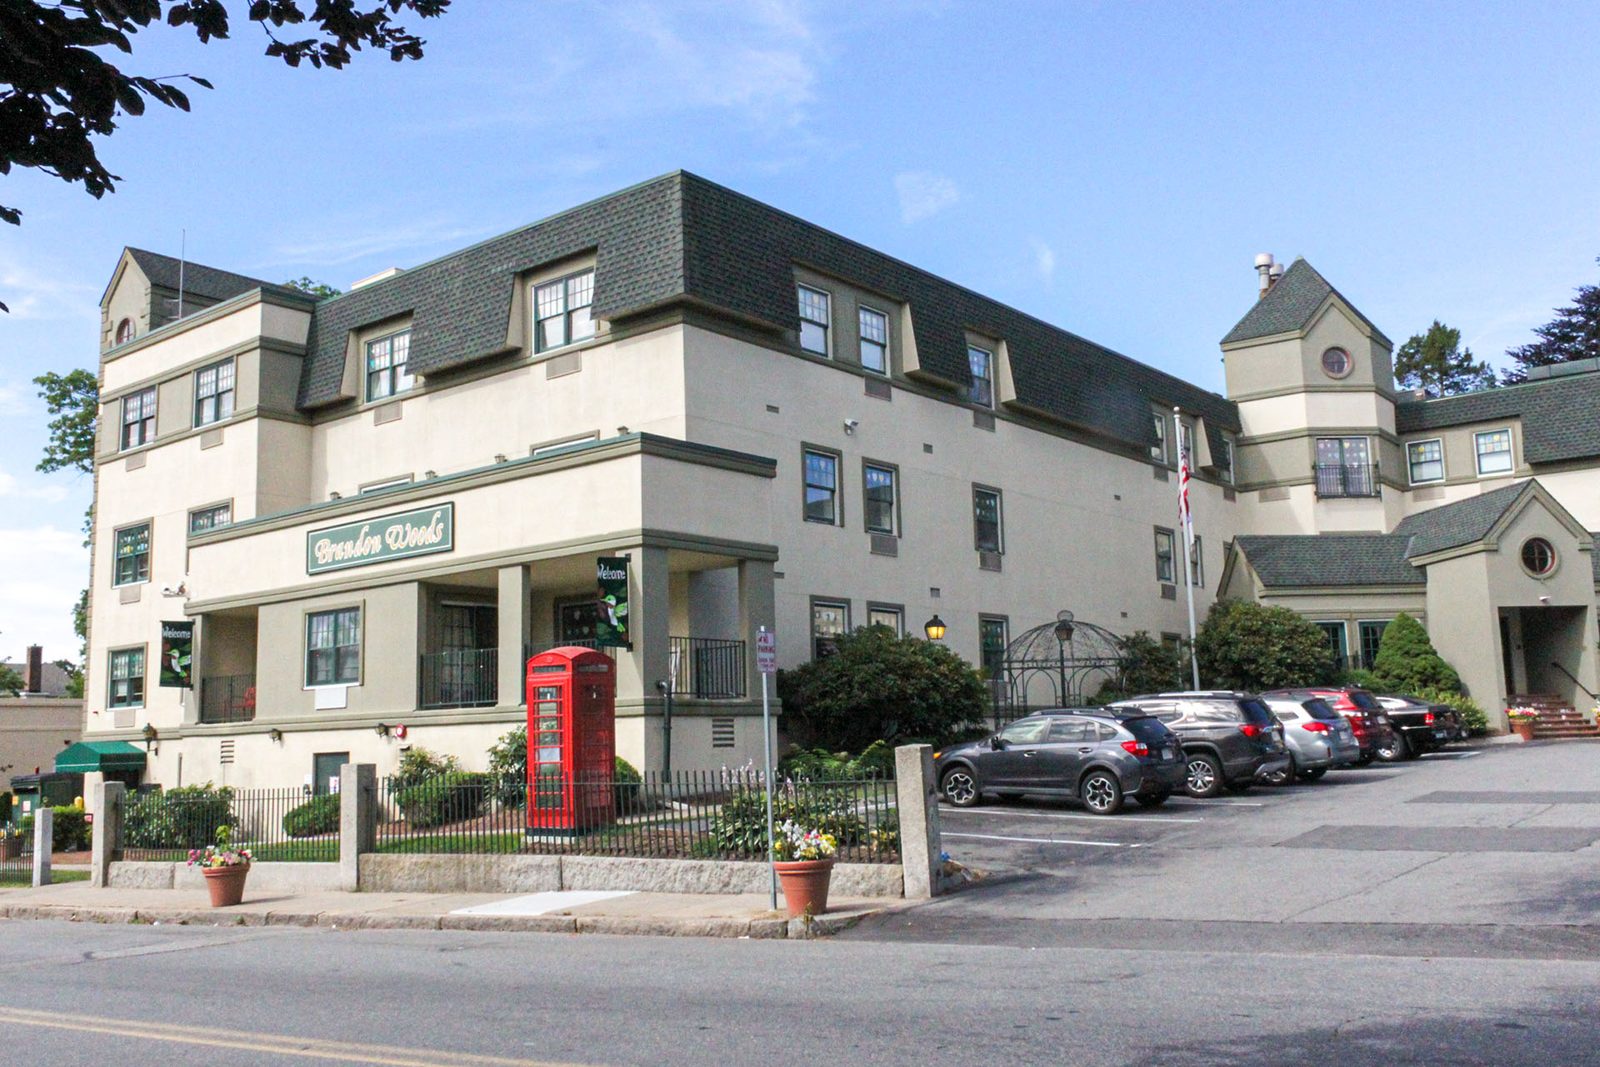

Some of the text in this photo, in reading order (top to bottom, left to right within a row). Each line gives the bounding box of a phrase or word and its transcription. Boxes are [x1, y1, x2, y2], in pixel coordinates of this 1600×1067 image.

[315, 511, 444, 564] Brandon Woods
[597, 563, 626, 579] Welcome
[162, 626, 191, 638] Welcome
